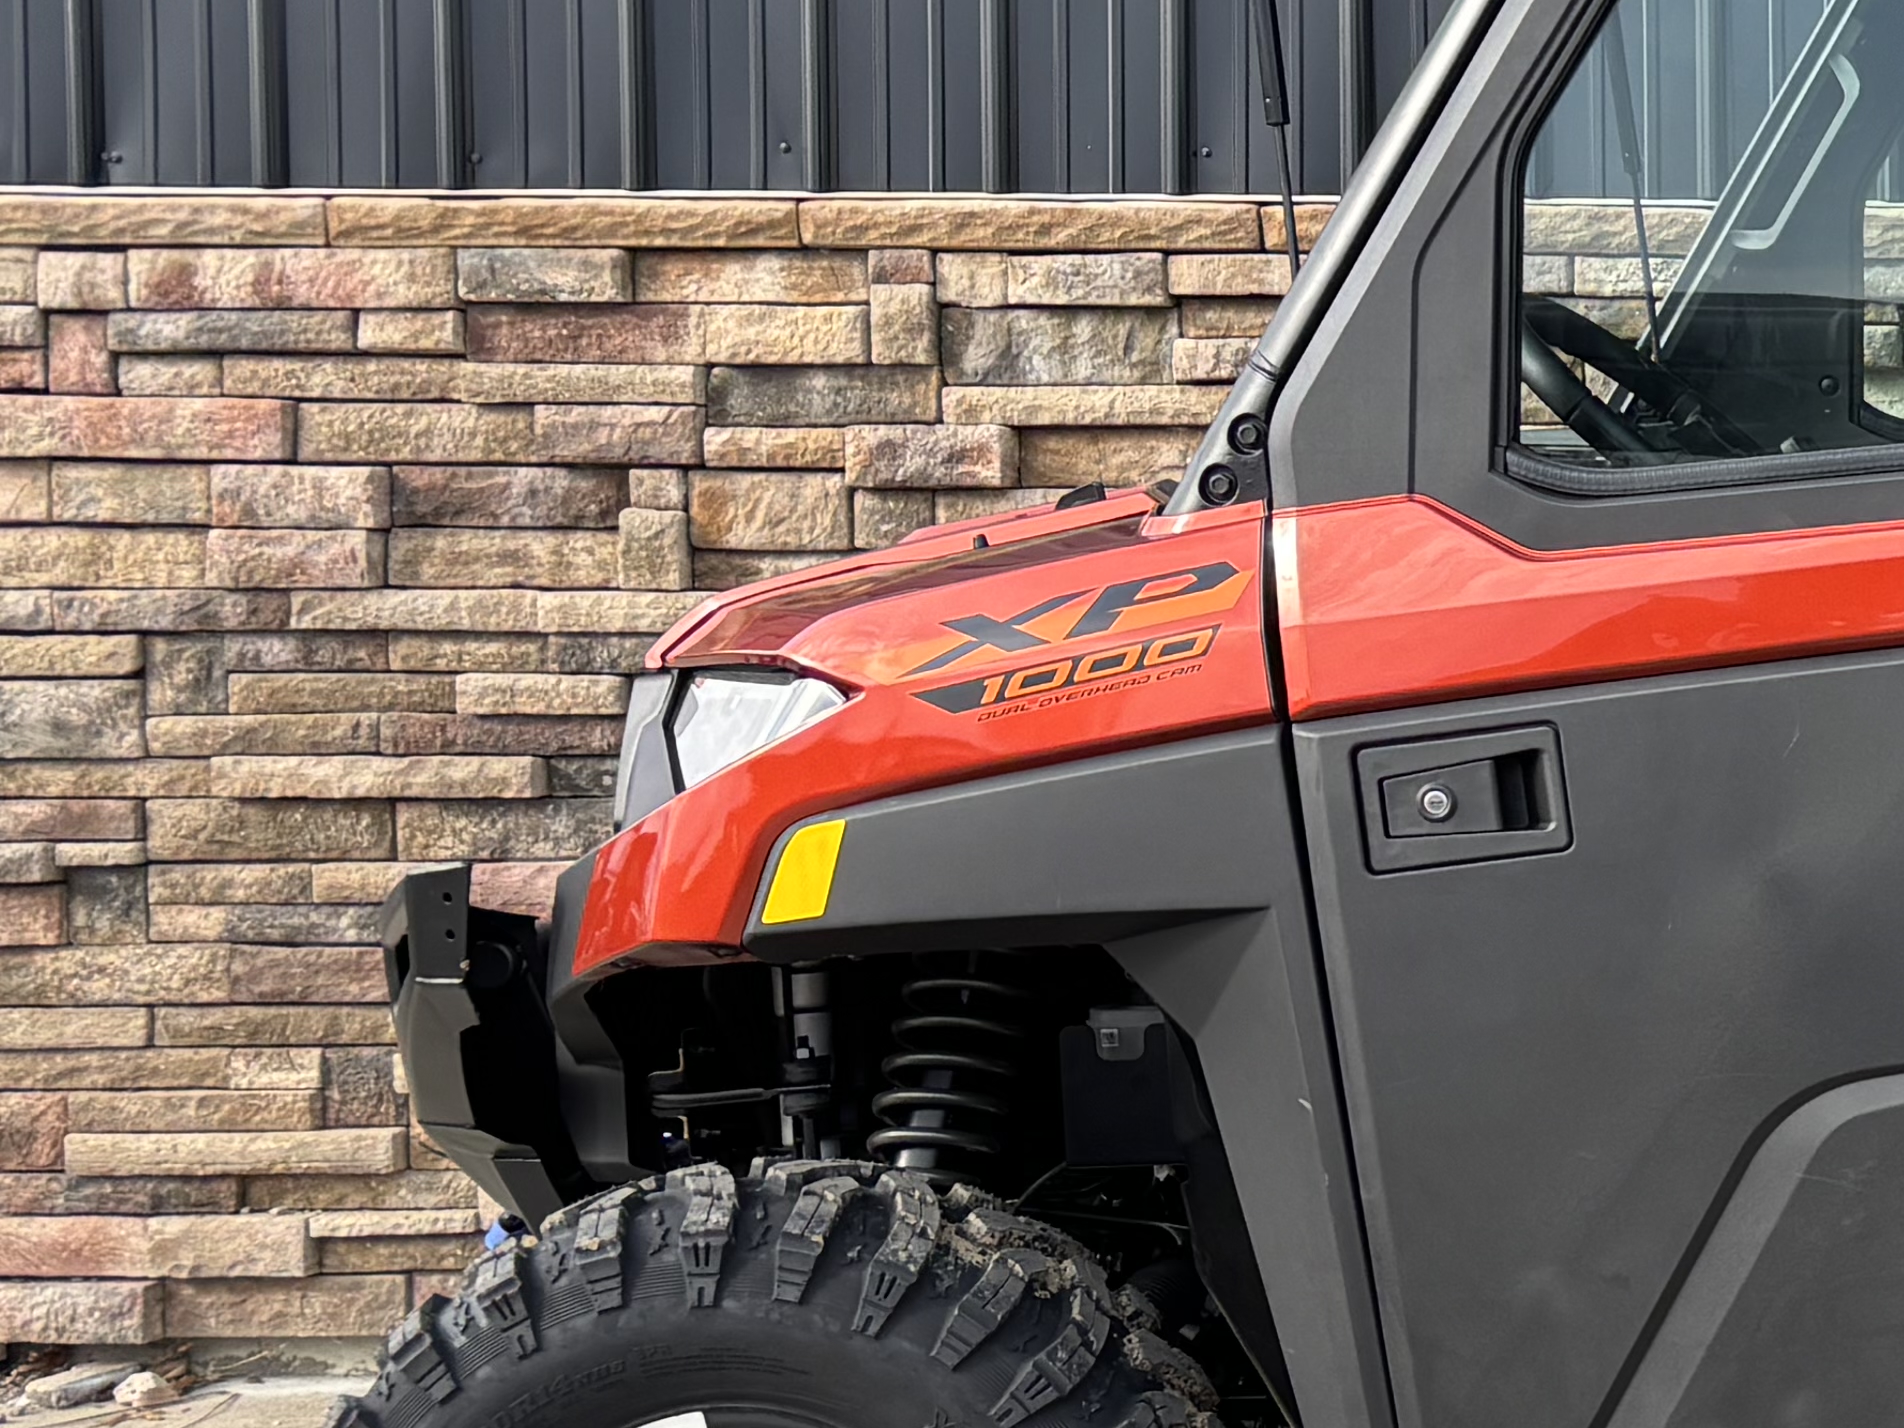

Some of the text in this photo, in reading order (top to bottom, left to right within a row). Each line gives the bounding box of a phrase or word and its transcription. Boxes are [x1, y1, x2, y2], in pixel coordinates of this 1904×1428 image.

[896, 560, 1241, 680] XP
[977, 663, 1202, 723] DUAL OVERHEAD CAM
[980, 627, 1214, 705] 1000
